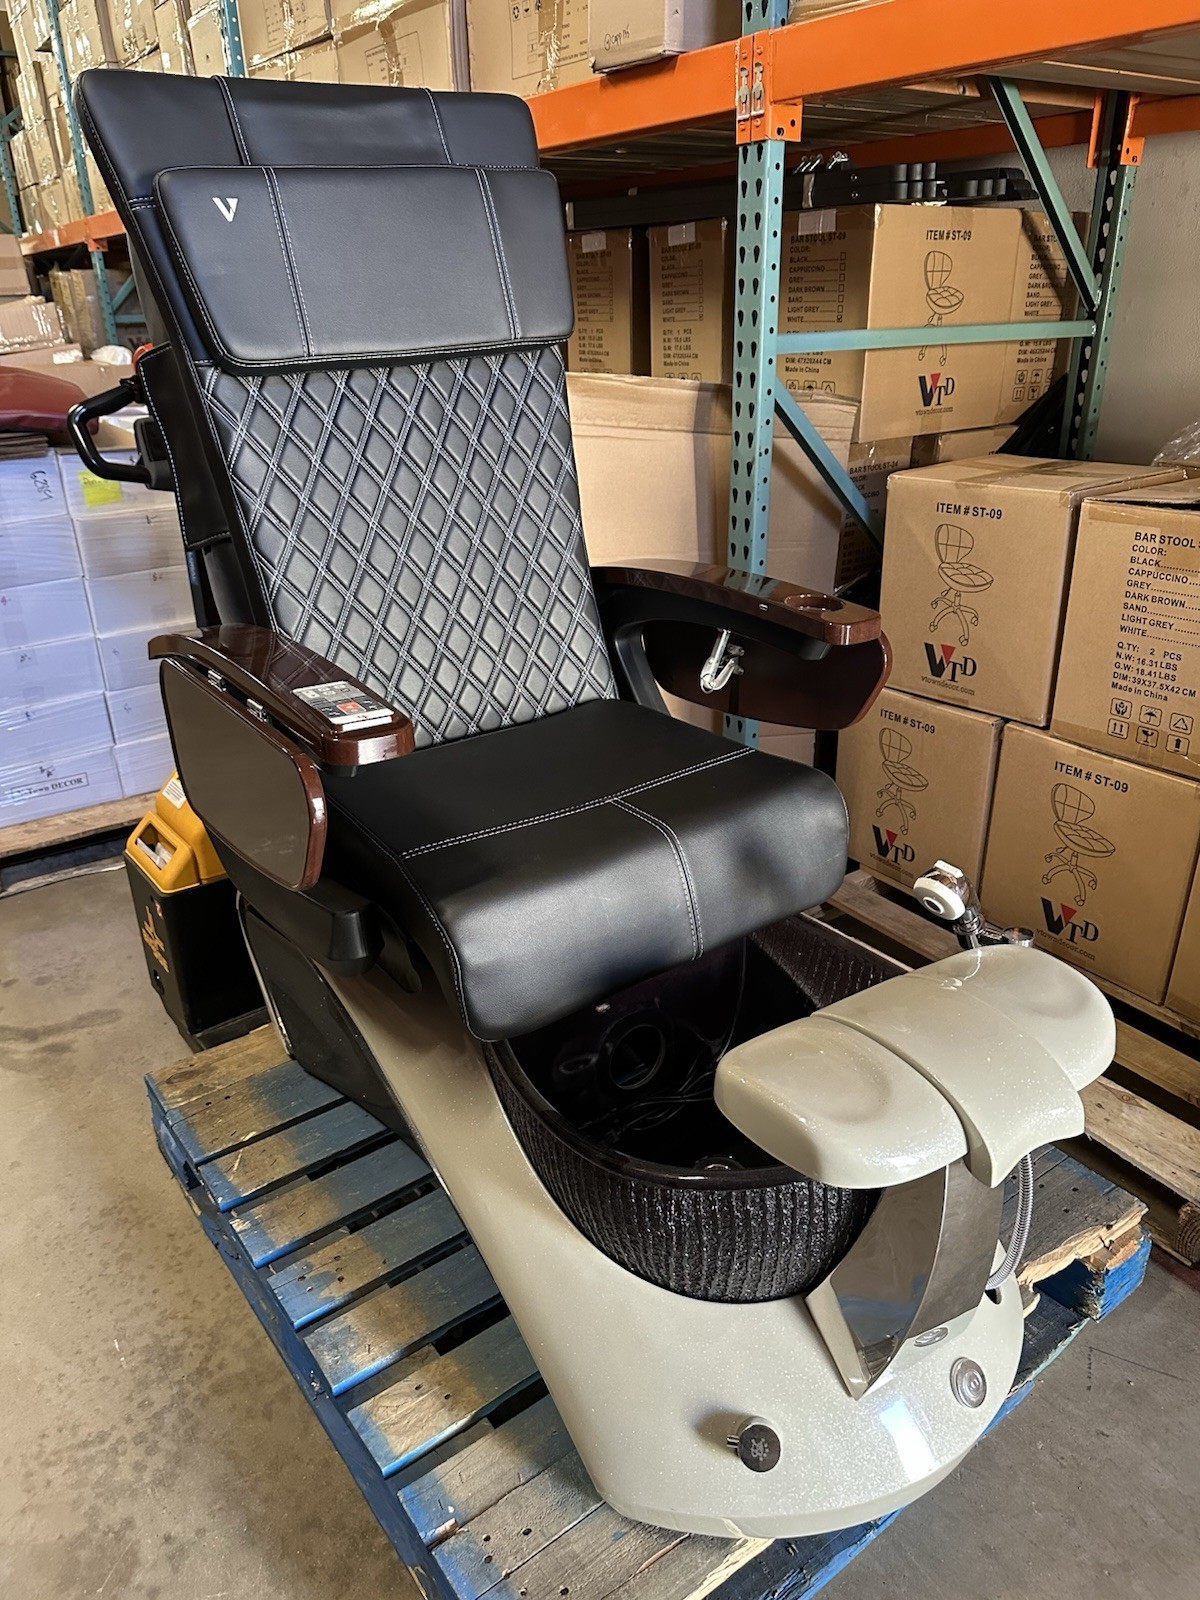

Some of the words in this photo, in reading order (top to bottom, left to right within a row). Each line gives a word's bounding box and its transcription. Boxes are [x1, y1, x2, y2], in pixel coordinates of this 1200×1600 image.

[926, 230, 945, 240] ITEM
[945, 230, 951, 240] #
[951, 230, 972, 241] ST-09
[936, 502, 961, 514] ITEM
[963, 505, 970, 516] #
[972, 506, 1002, 519] ST-09
[1134, 531, 1157, 543] BAR
[1159, 535, 1196, 549] STOOL
[1132, 544, 1167, 556] COLOR:
[1128, 567, 1188, 584] CAPPUCCINO
[1125, 590, 1149, 602] DARK
[1121, 613, 1147, 625] LIGHT
[1149, 618, 1174, 630] GREY
[1116, 651, 1135, 662] N.W:
[1160, 661, 1178, 671] LBS
[1163, 651, 1182, 661] PCS
[1114, 661, 1134, 672] G.W:
[1158, 671, 1177, 682] LBS
[1111, 681, 1133, 692] Made
[1134, 687, 1142, 695] in
[1144, 689, 1168, 701] China
[1182, 688, 1197, 698] CM
[880, 709, 902, 723] ITEM
[902, 716, 909, 726] #
[910, 718, 935, 734] ST-09
[51, 777, 84, 790] DECOR
[1054, 761, 1083, 779] ITEM
[1084, 770, 1092, 781] #
[1094, 774, 1128, 793] ST-09
